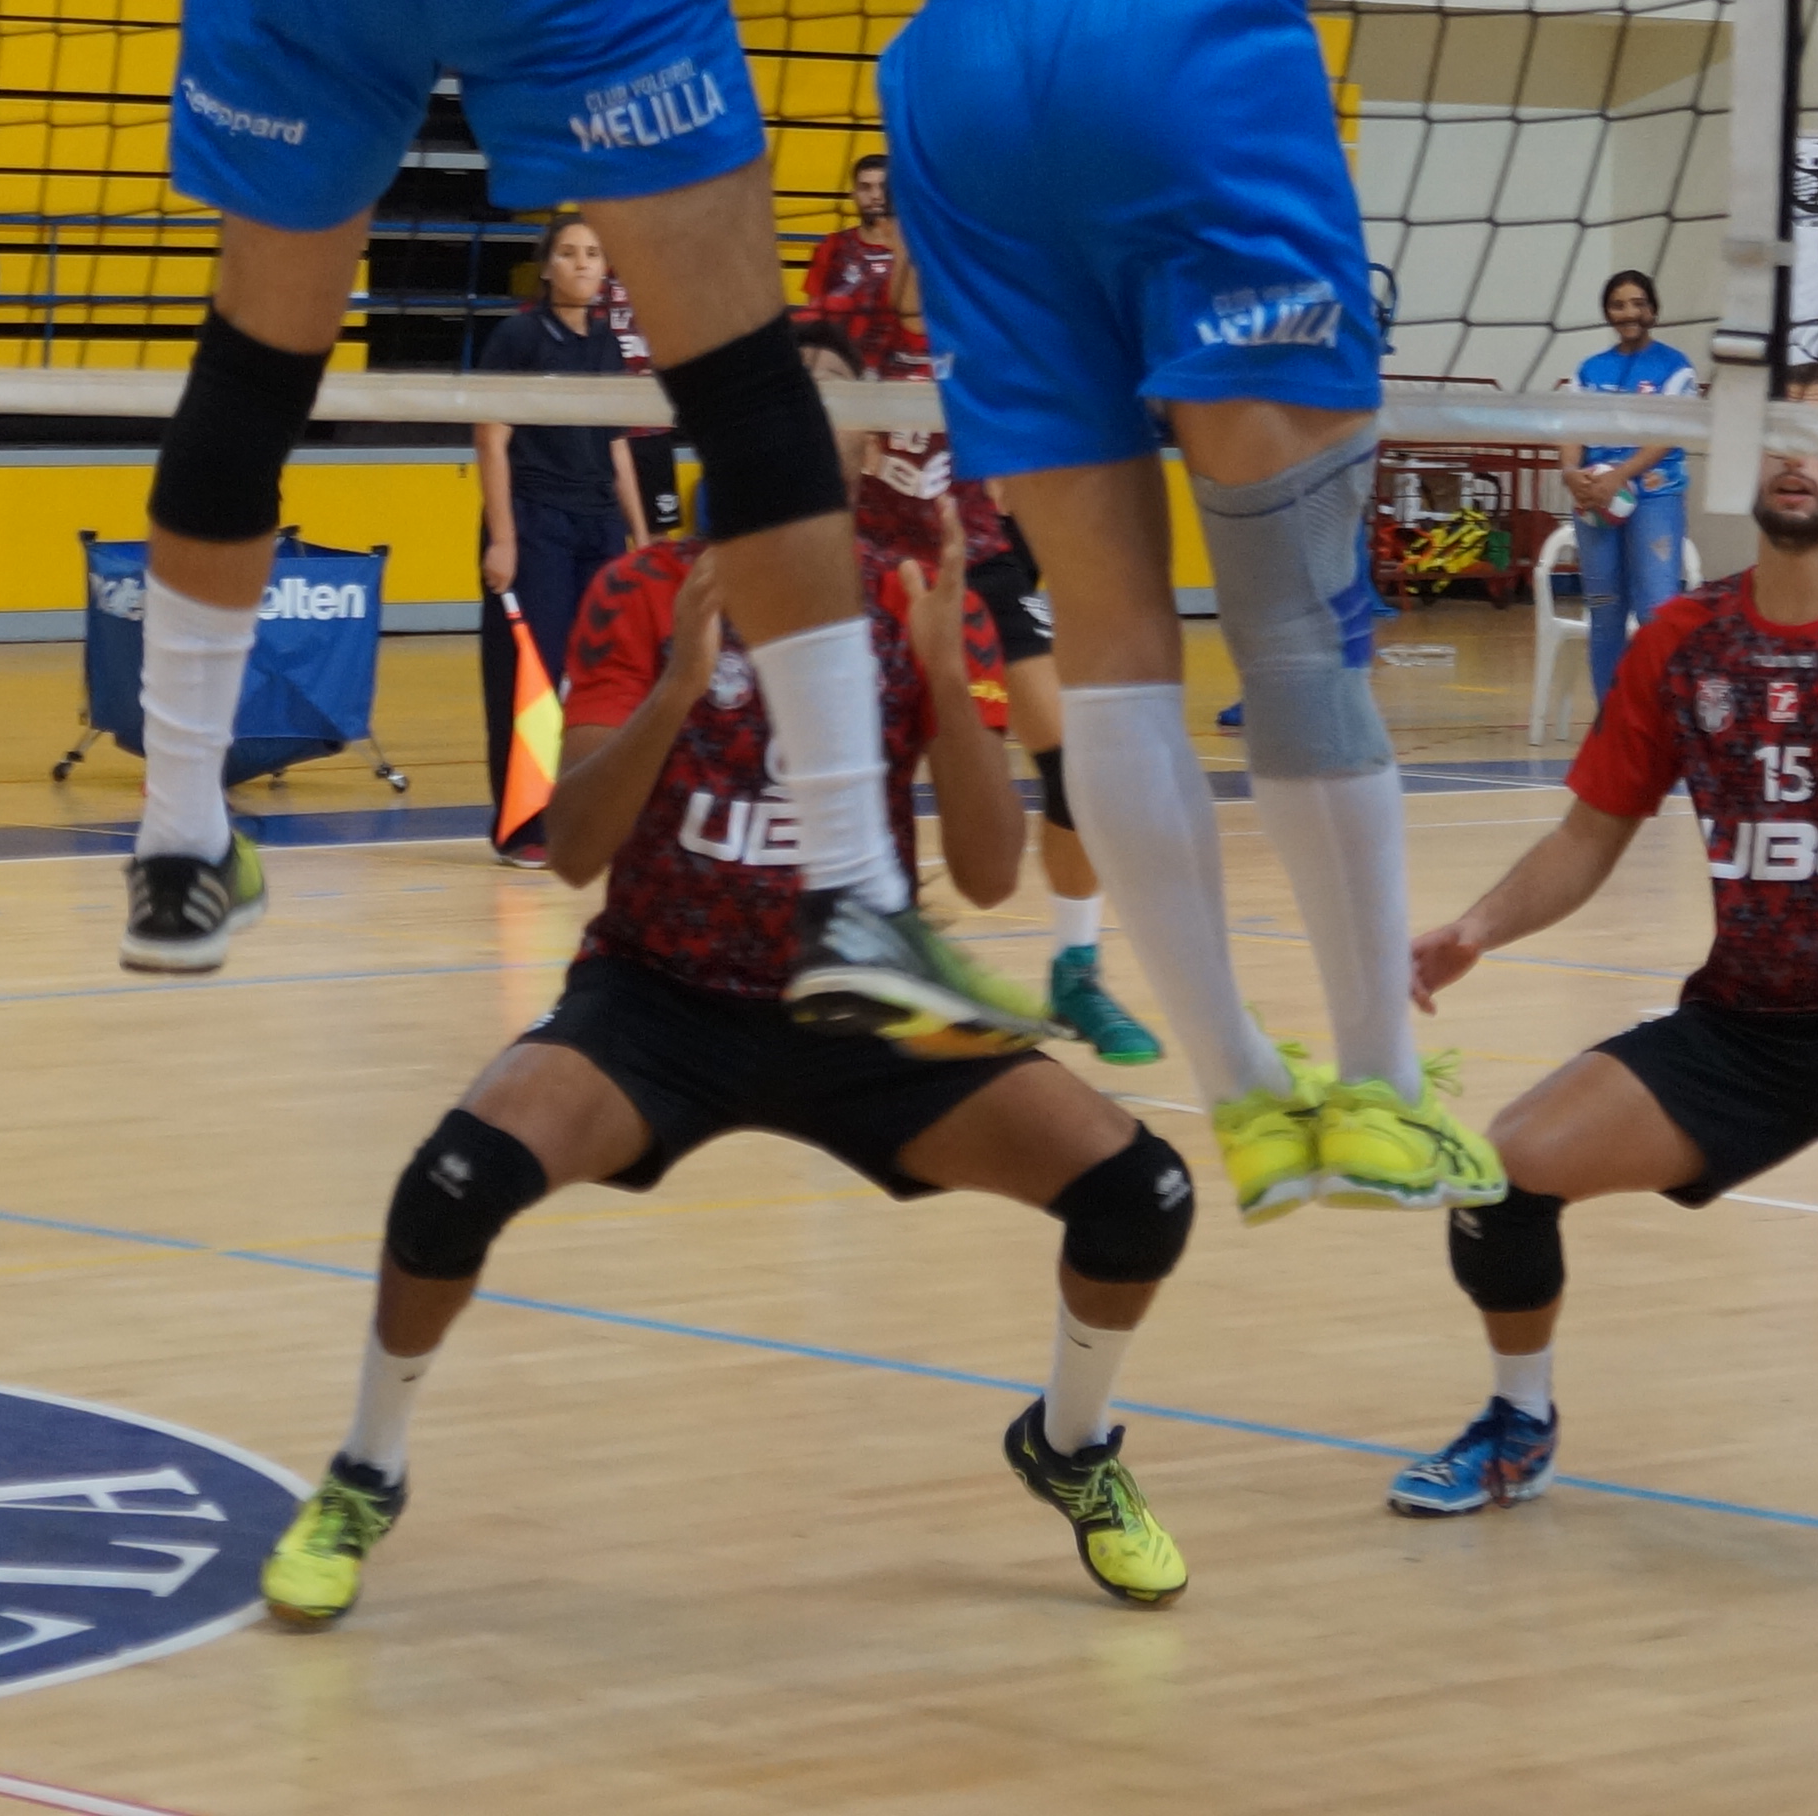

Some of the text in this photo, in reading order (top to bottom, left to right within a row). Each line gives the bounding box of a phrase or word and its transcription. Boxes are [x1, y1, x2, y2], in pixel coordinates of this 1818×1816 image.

[568, 69, 726, 152] MELILLA
[256, 578, 366, 620] olten
[1754, 746, 1815, 802] 15
